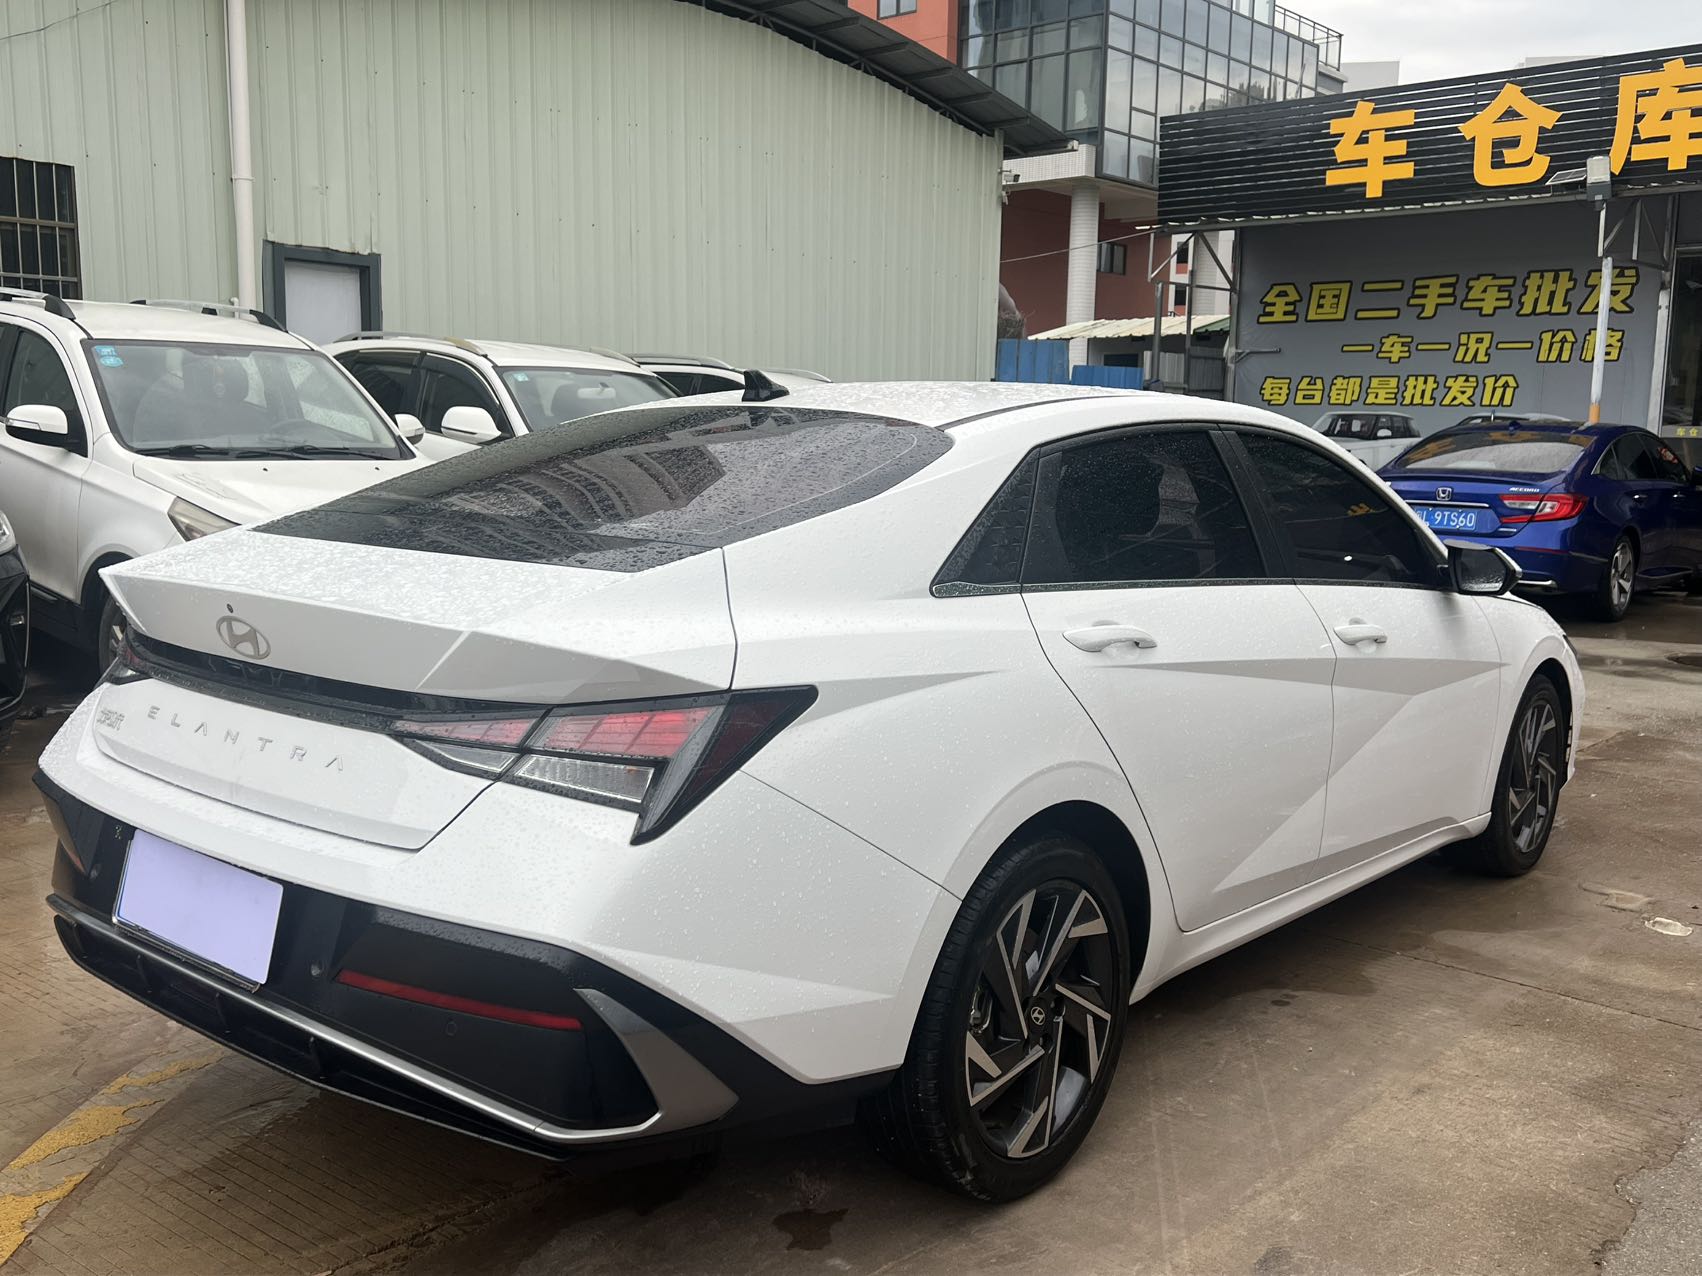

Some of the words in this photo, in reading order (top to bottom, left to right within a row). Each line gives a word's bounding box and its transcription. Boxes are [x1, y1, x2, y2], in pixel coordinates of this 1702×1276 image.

[1257, 266, 1639, 324] 全国二手车批发
[1341, 328, 1624, 363] 一车一况一价格
[1260, 374, 1519, 407] 每台都是批发价
[147, 704, 344, 772] ELANTRA
